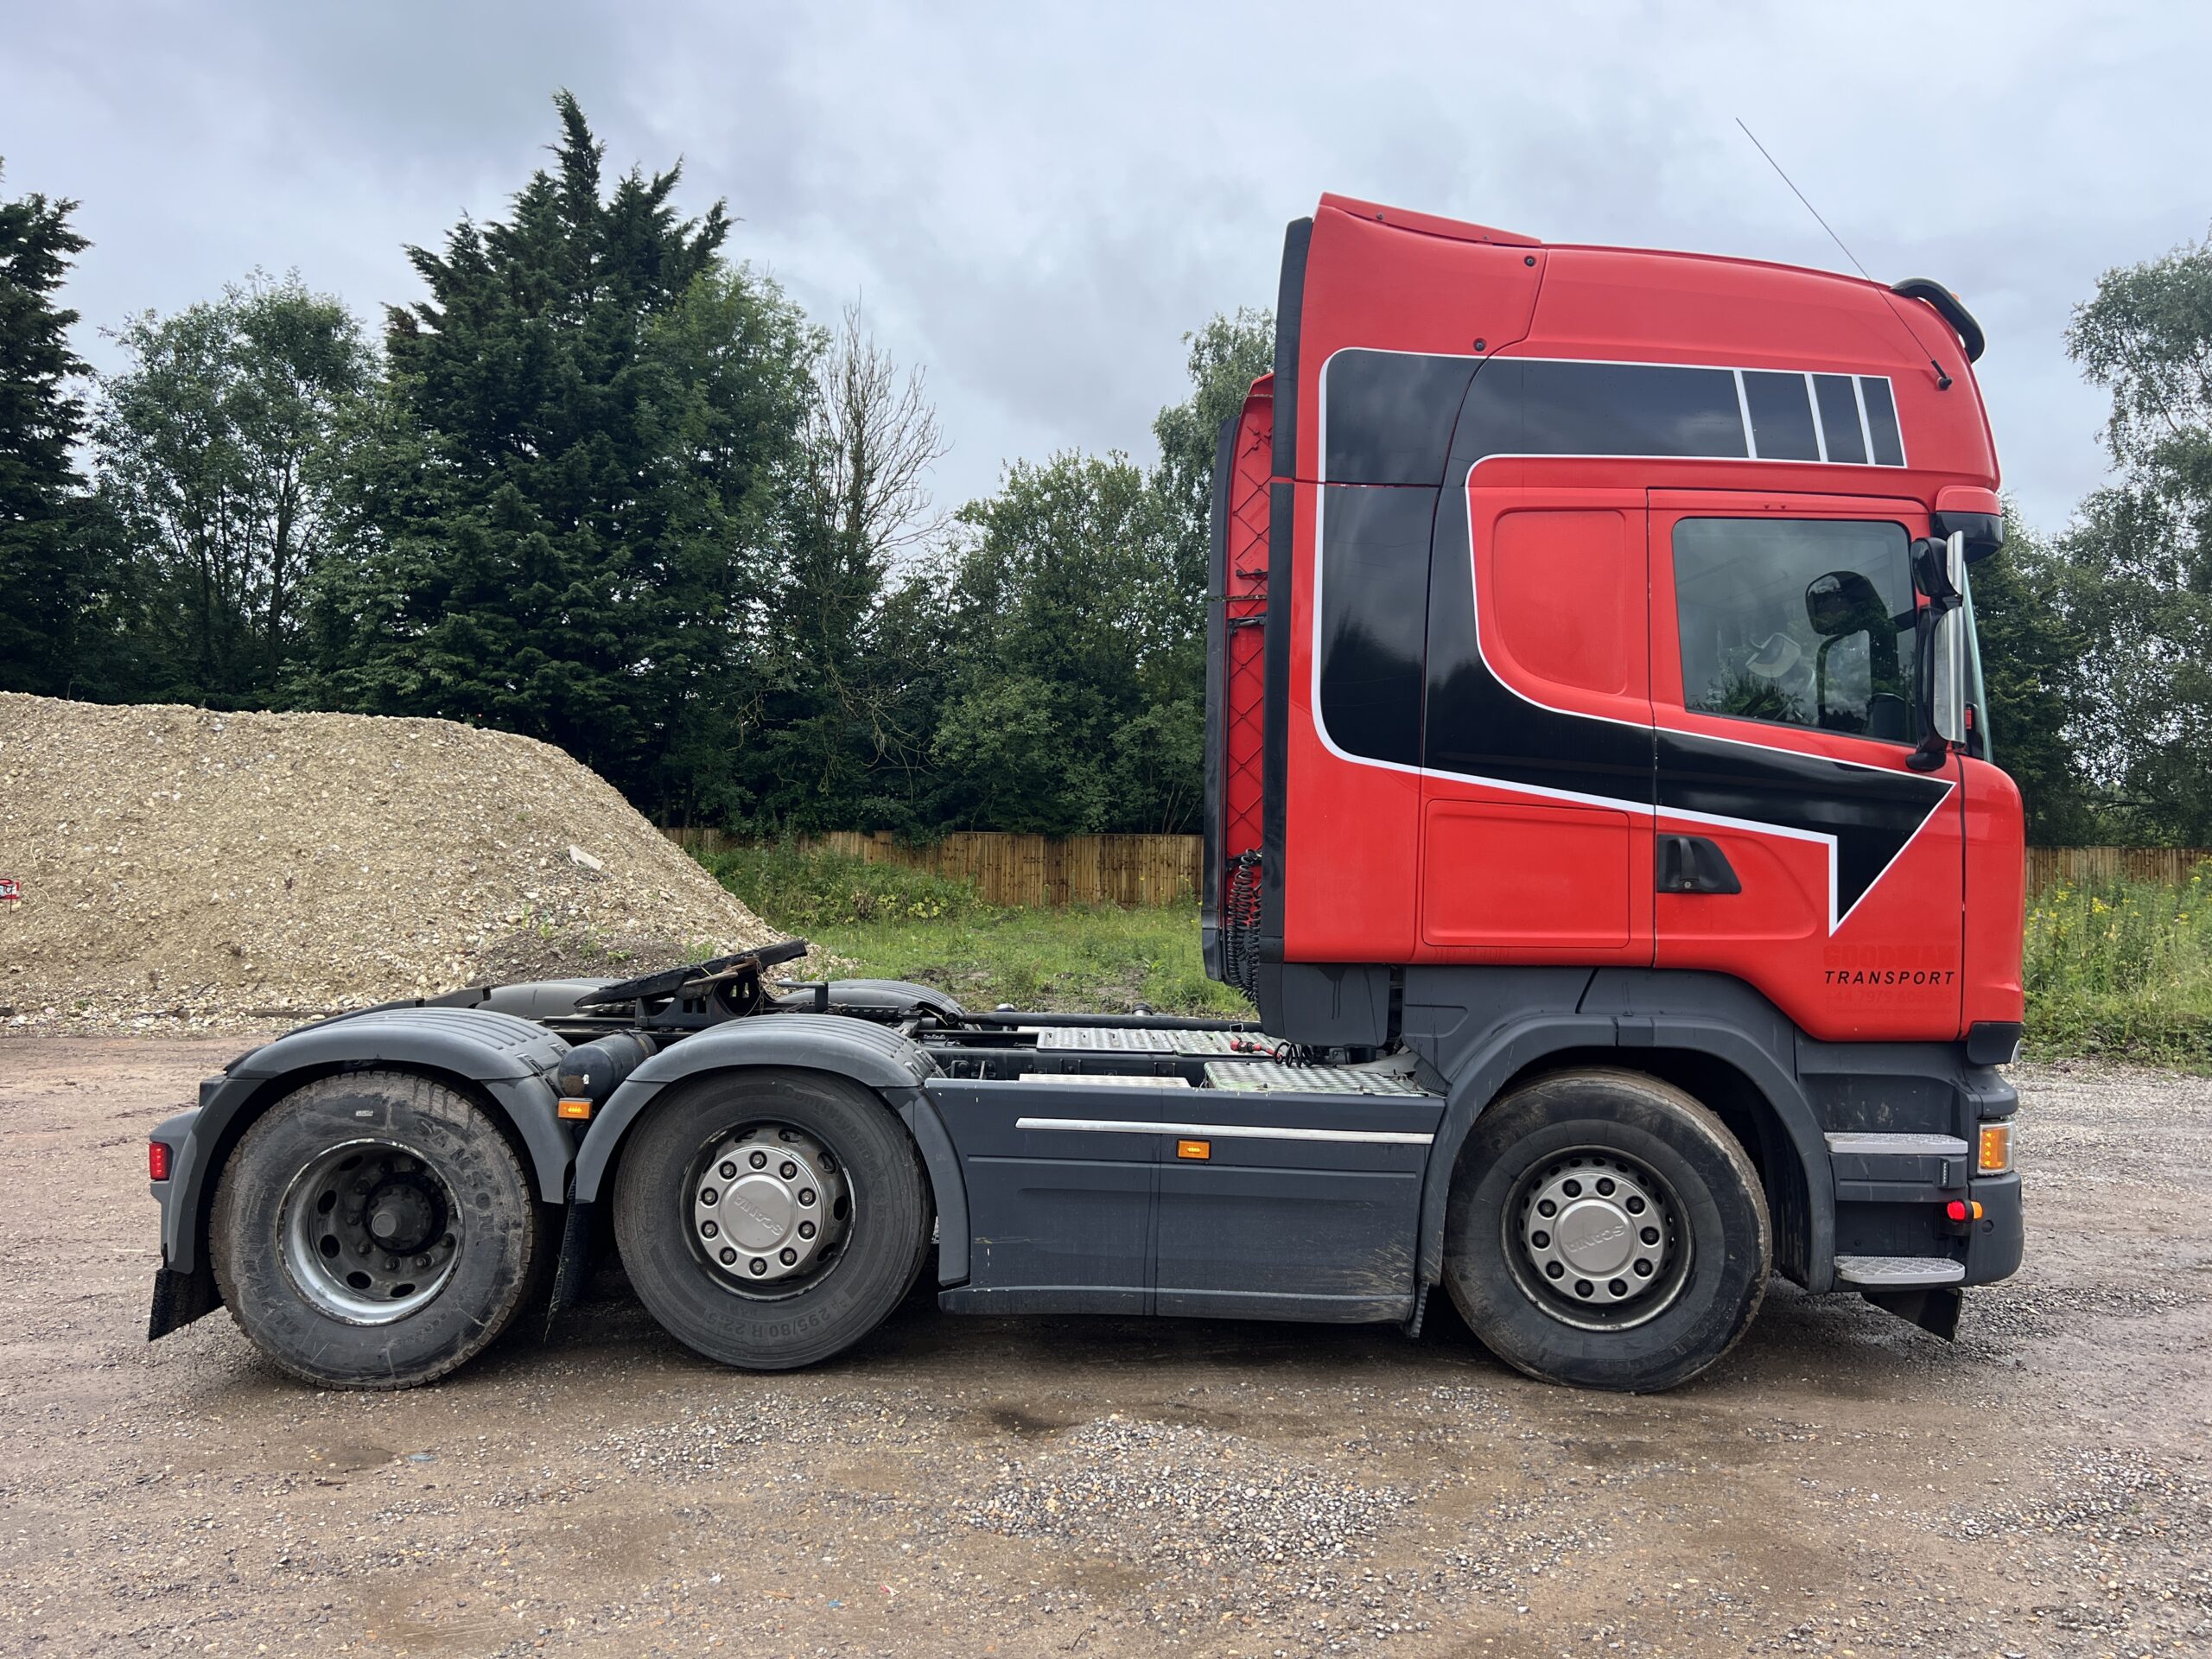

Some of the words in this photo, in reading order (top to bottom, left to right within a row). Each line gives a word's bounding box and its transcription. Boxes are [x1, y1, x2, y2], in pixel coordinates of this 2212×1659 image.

[1825, 970, 1955, 985] TRANSPORT
[734, 1192, 784, 1236] SCANIA
[1564, 1224, 1627, 1254] SCANIA
[704, 1310, 746, 1336] 22.5
[768, 1306, 832, 1338] 295/80
